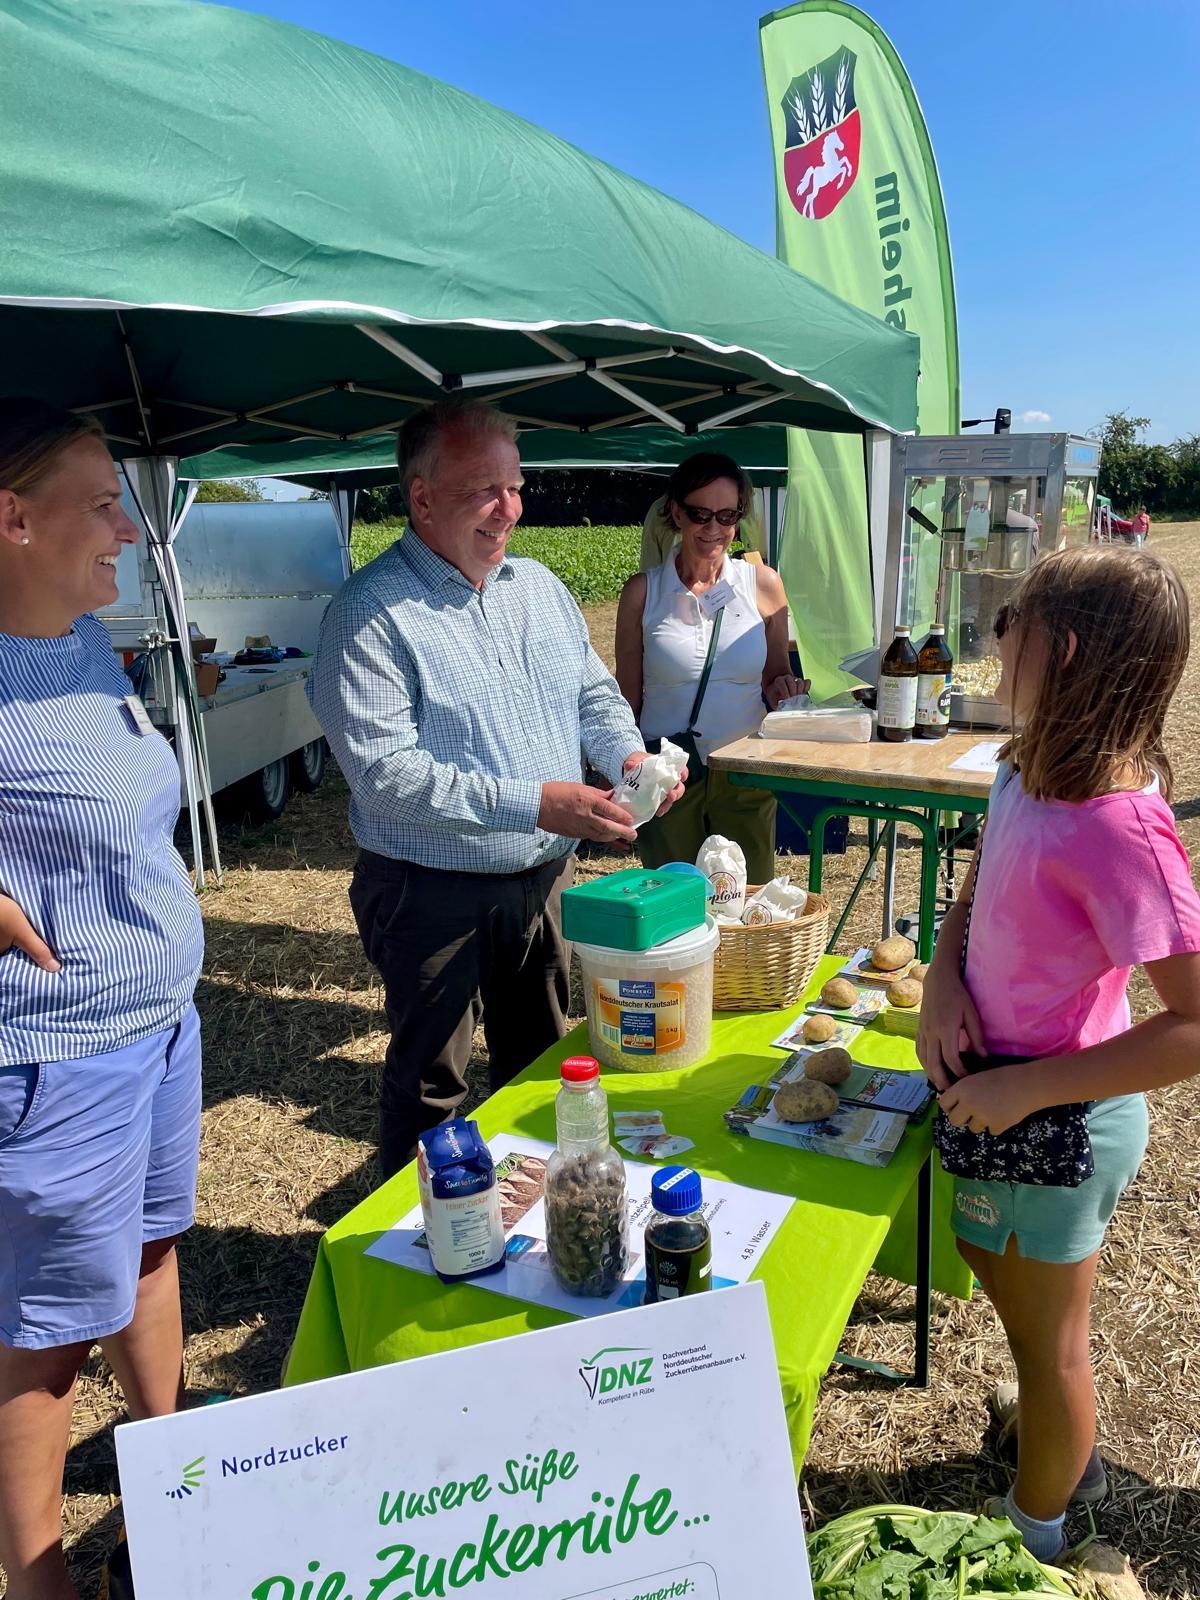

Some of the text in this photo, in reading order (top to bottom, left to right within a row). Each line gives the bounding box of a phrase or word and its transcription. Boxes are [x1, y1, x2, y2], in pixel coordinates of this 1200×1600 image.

[940, 698, 950, 707] RAP
[600, 993, 679, 1009] Norddeutscher Krautsalat
[741, 1247, 755, 1261] 4,8
[750, 1220, 772, 1245] Wasser
[468, 1250, 481, 1258] 1000
[662, 1344, 707, 1360] Dachverband
[663, 1352, 713, 1369] Norddeutscher
[665, 1353, 747, 1378] Zuckerrübenanbauer e.V.
[599, 1357, 654, 1394] DNZ
[598, 1392, 631, 1405] Kompetenz
[639, 1386, 655, 1395] Rübe
[221, 1434, 349, 1477] Nordzucker
[378, 1449, 580, 1526] Unsere Süße
